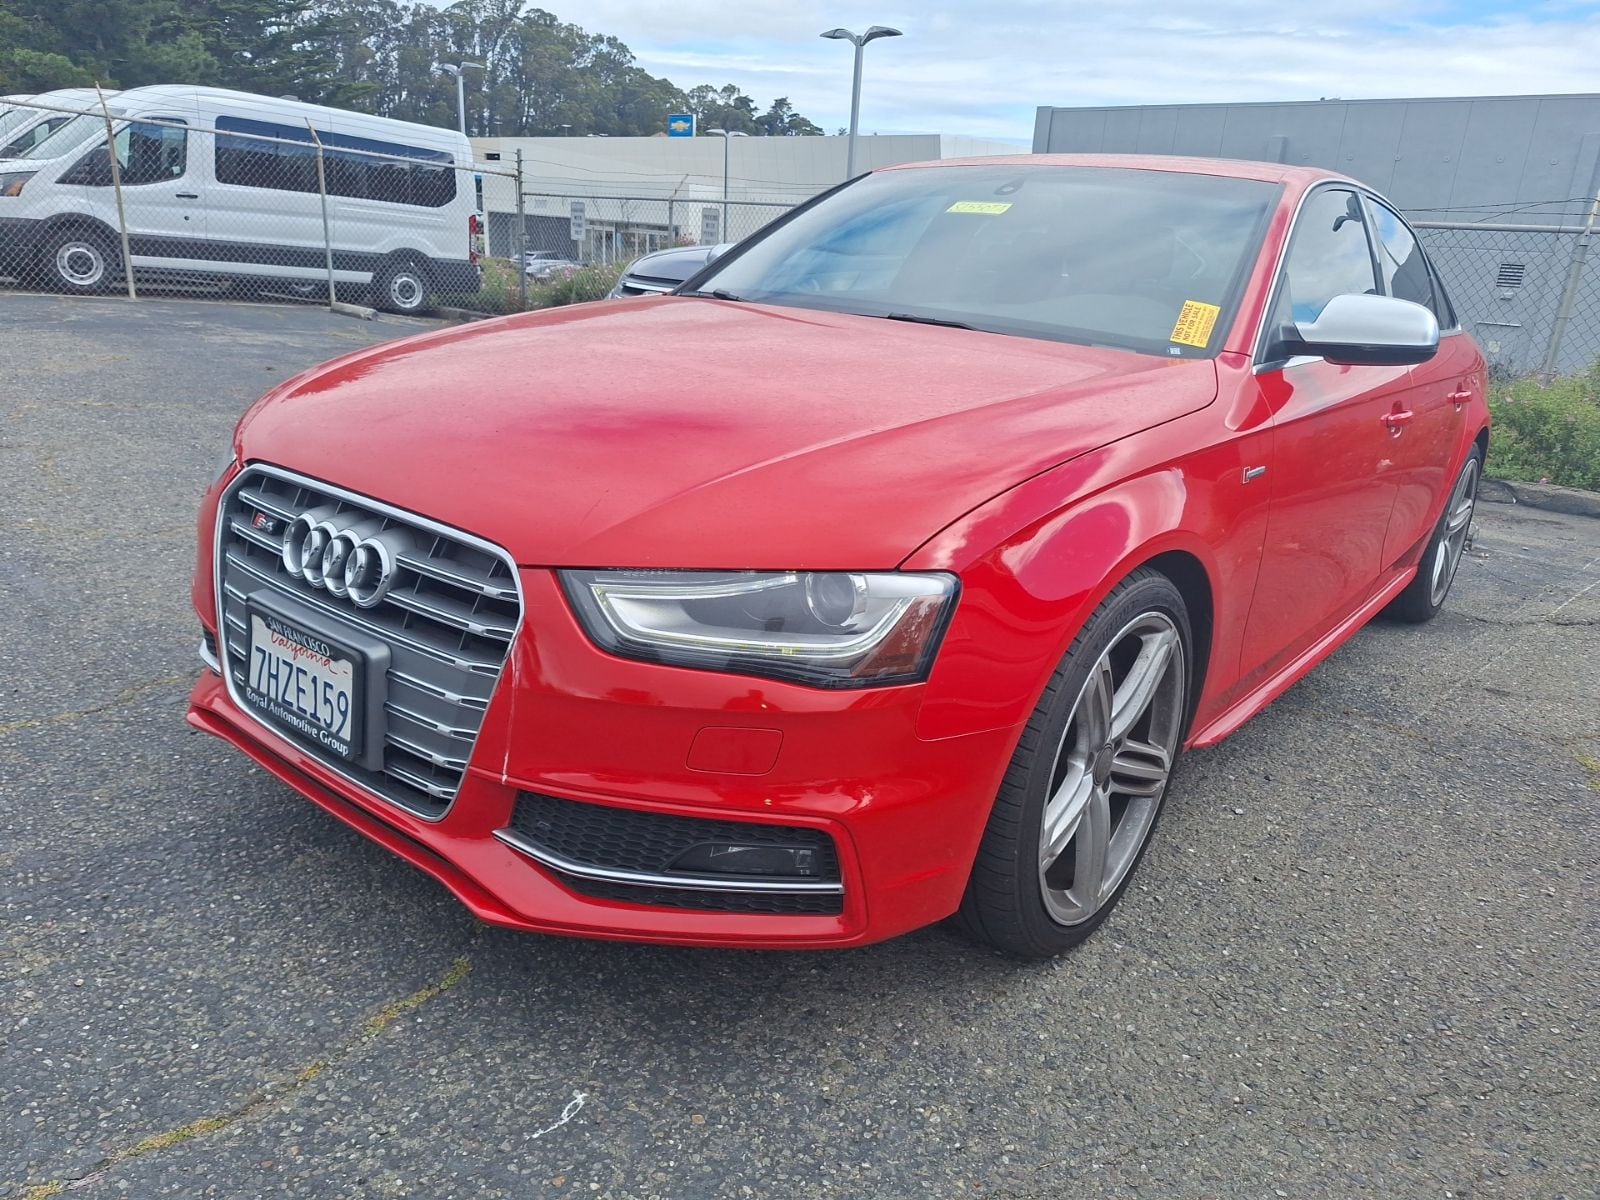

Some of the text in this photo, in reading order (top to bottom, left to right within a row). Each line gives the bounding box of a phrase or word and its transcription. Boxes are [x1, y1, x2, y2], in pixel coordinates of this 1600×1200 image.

[1172, 303, 1194, 340] THIS VEHICLE
[1182, 331, 1192, 342] NOT
[1187, 319, 1196, 330] FOR
[268, 616, 330, 656] SAN FRANCISCO
[255, 645, 349, 735] 7HZE159
[246, 688, 349, 756] Royal Automotive Group
